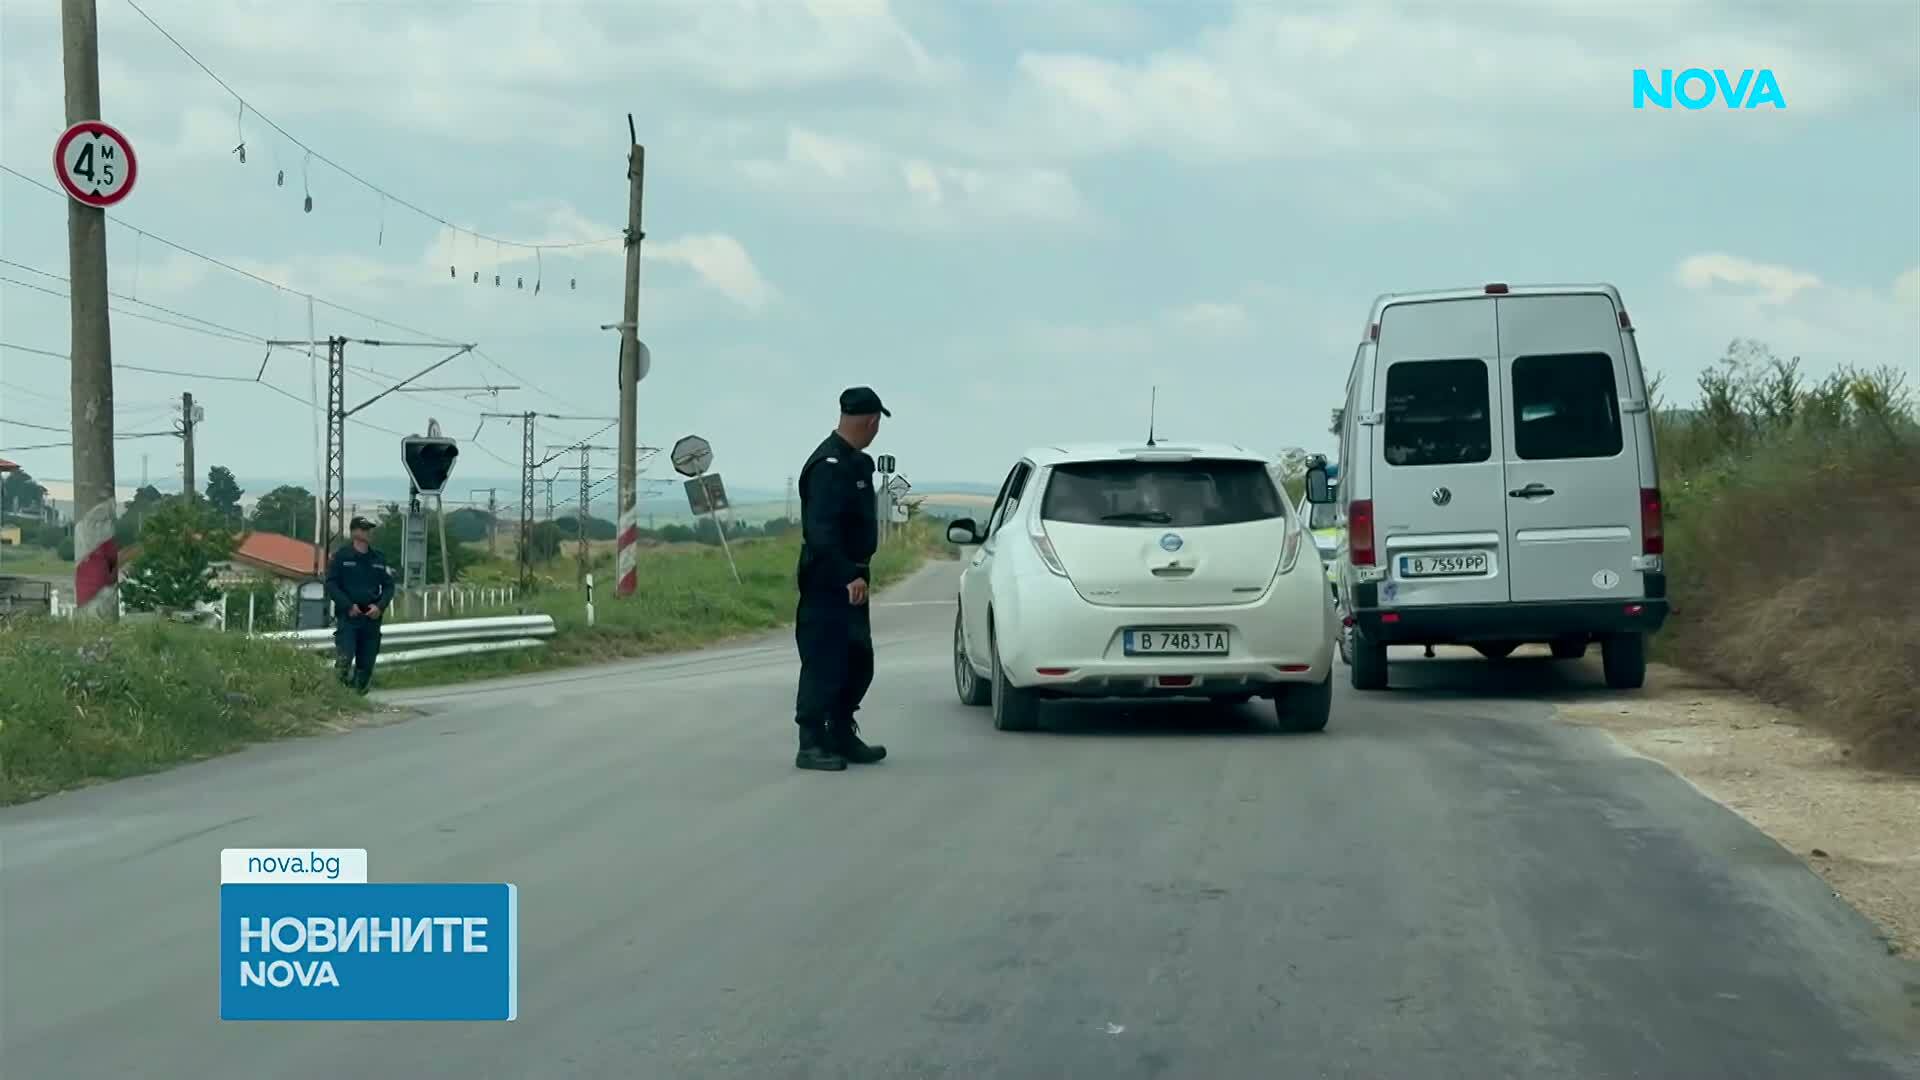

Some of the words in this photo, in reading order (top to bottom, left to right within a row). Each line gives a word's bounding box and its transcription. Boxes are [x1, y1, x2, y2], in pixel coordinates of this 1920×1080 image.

[1142, 633, 1152, 650] B
[1160, 633, 1200, 650] 7483
[1203, 632, 1224, 649] TA
